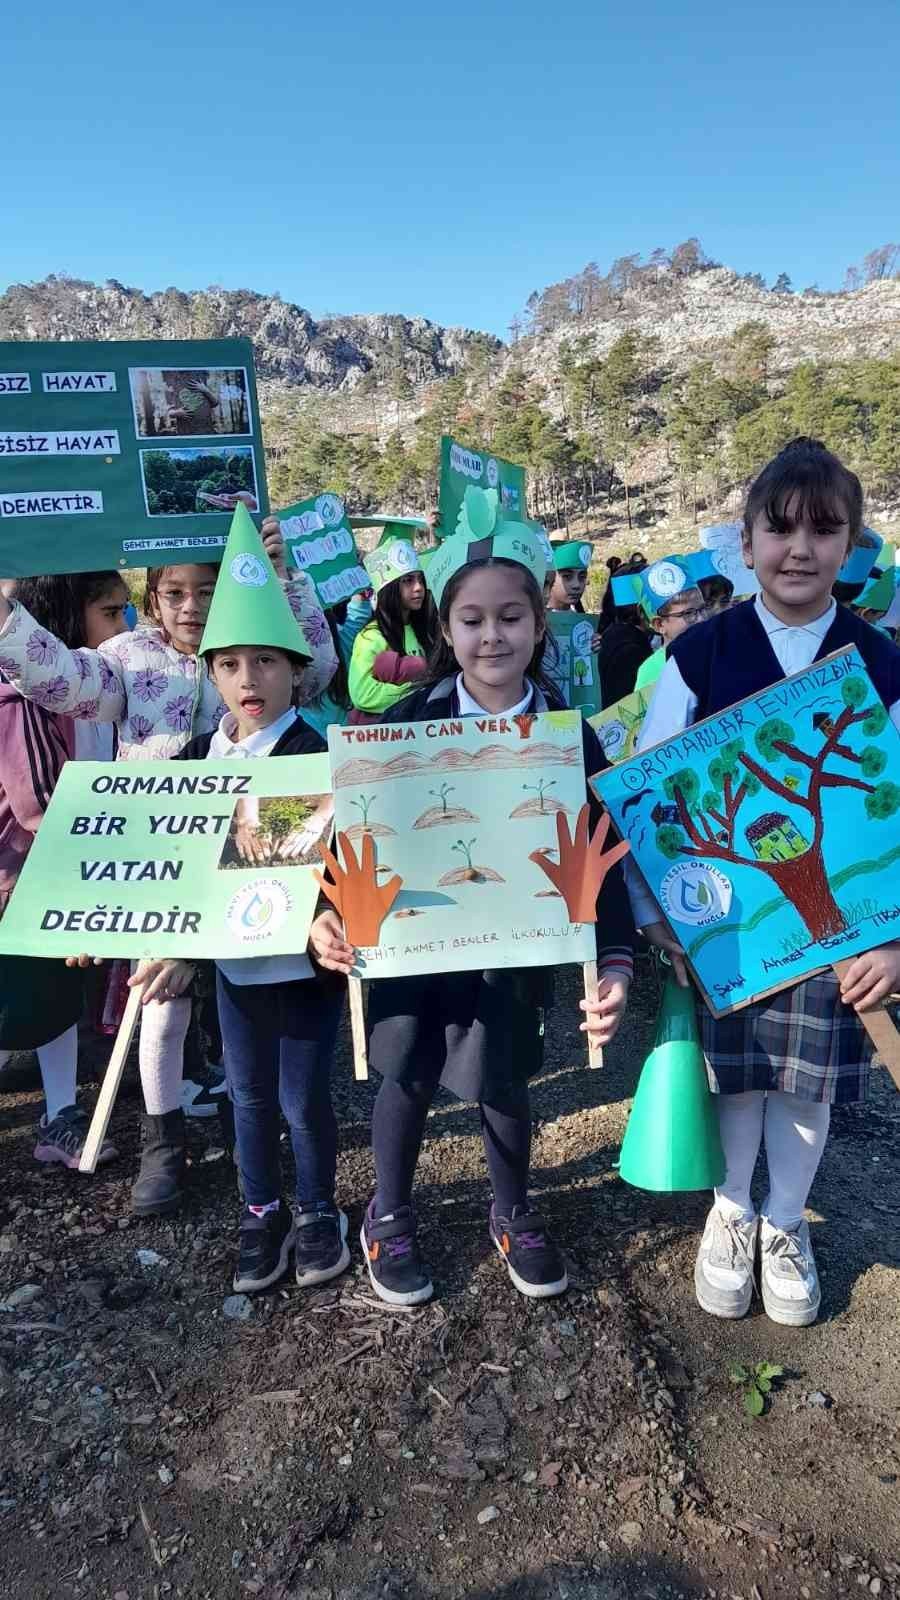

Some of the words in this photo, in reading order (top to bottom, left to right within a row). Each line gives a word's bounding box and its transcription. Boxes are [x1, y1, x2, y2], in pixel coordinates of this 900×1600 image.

[56, 435, 115, 450] HAYAT
[2, 493, 100, 514] DEMEKTİR.
[155, 539, 184, 547] AHMET
[341, 727, 416, 743] TOHUMA
[425, 722, 463, 738] CAN
[91, 775, 253, 795] ORMANSIZ
[70, 811, 127, 835] BİR
[148, 815, 230, 834] YURT
[80, 860, 183, 881] VATAN
[40, 904, 202, 934] DEĞİLDİR
